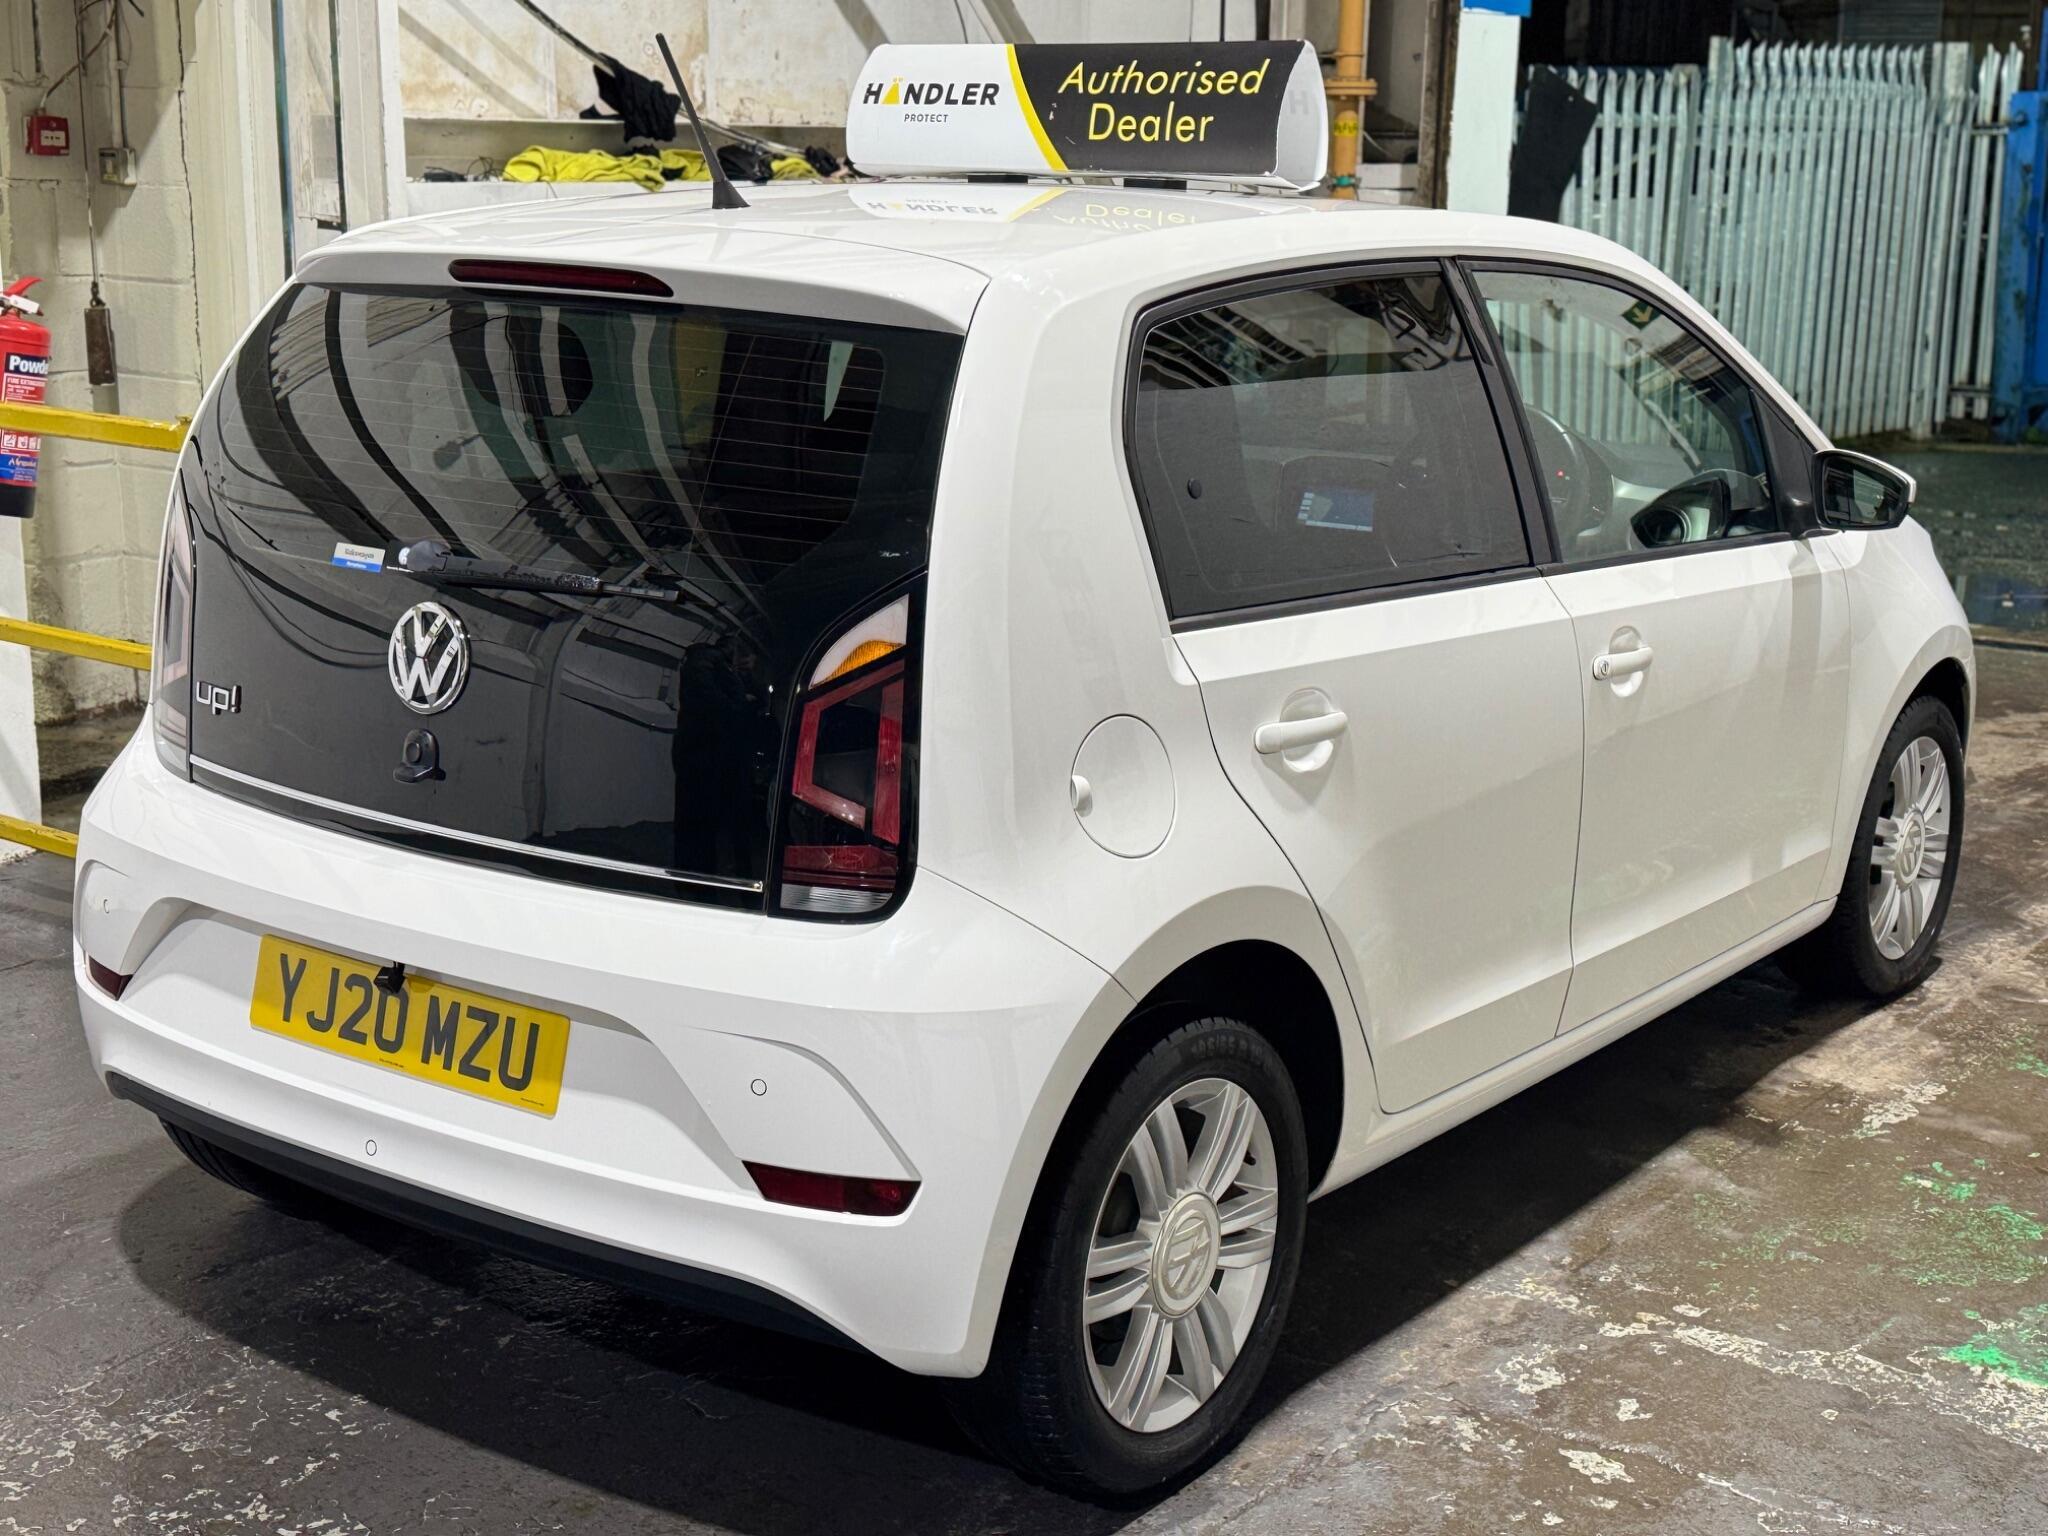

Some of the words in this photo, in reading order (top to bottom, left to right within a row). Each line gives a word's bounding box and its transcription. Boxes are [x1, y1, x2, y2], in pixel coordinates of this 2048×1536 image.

[1057, 58, 1272, 95] Authorised
[903, 113, 949, 123] PROTECT
[1088, 100, 1215, 143] Dealer
[196, 680, 241, 716] up!
[279, 952, 409, 1055] YJ20
[421, 994, 541, 1093] MZU
